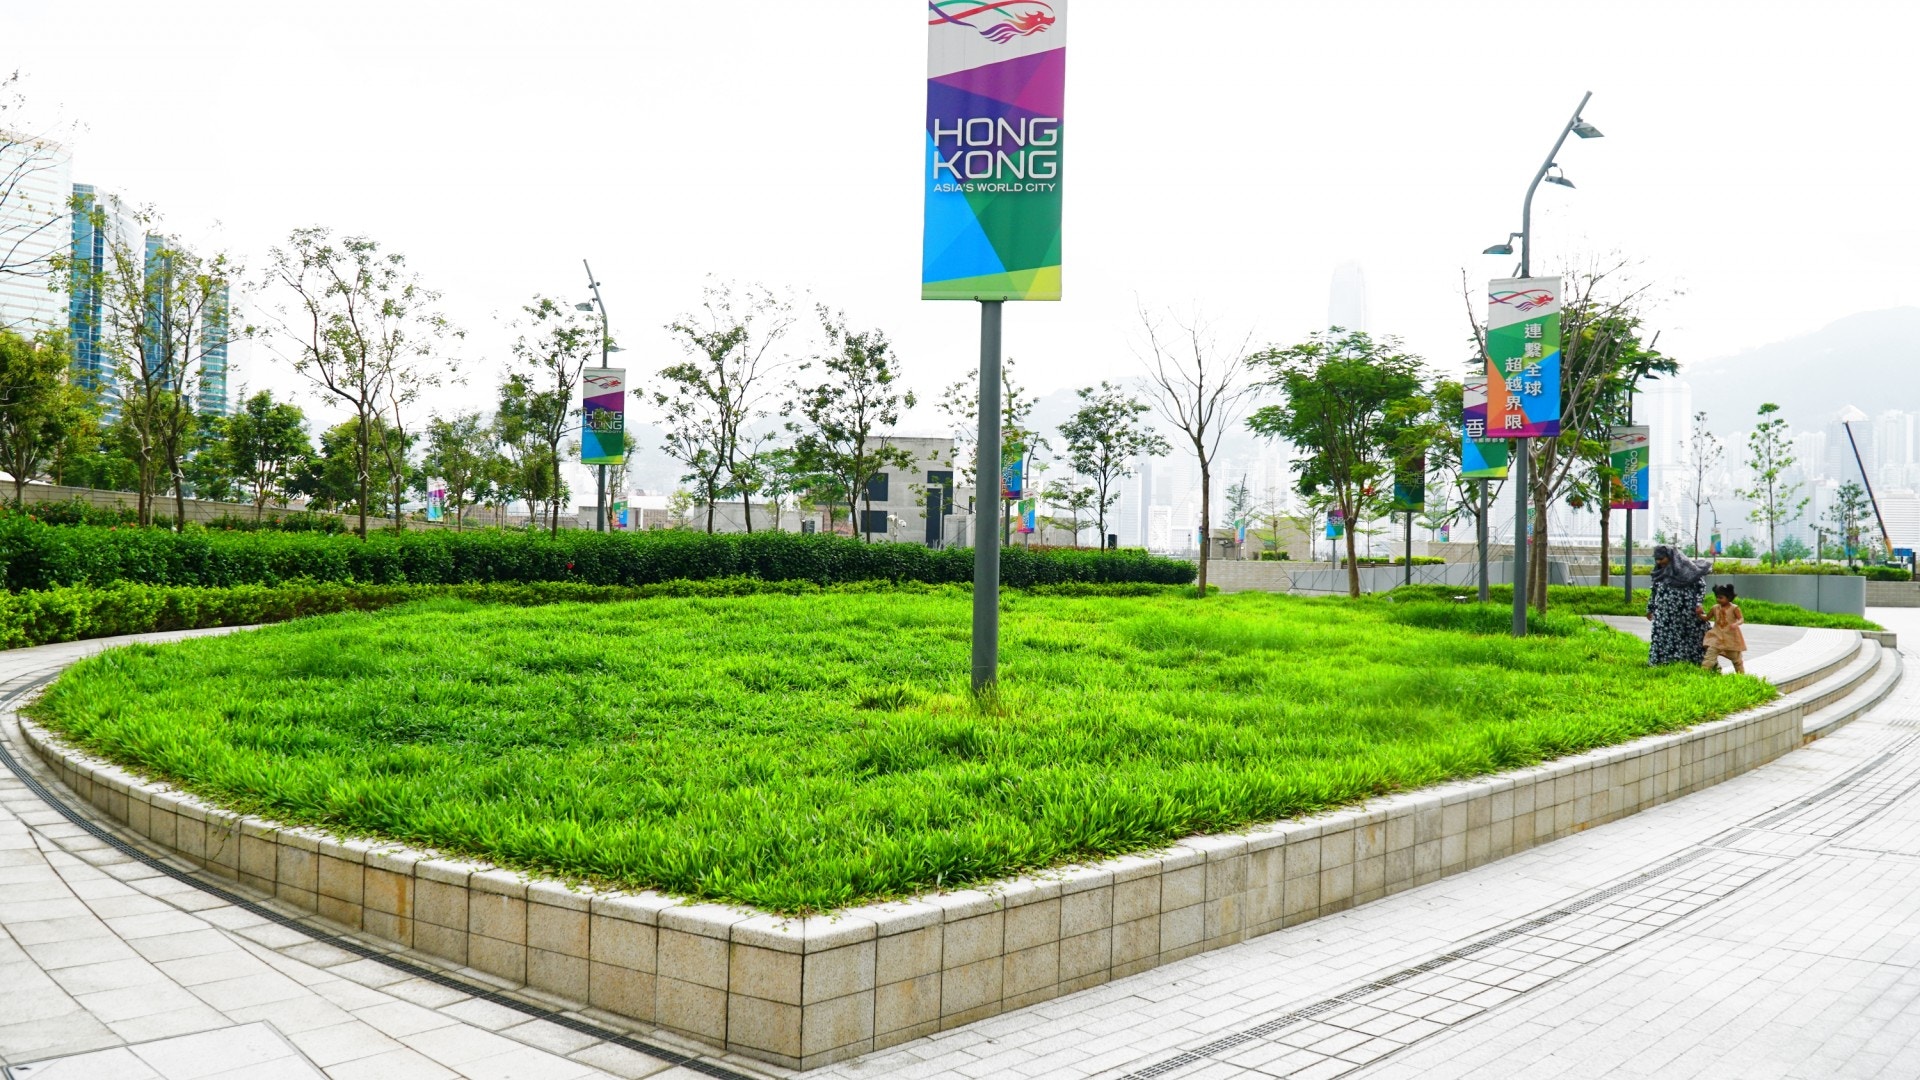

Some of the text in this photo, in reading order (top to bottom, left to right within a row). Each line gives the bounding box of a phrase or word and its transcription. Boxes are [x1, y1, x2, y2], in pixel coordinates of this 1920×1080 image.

[934, 117, 1058, 147] HONG
[933, 150, 1057, 180] KONG
[933, 183, 1056, 193] ASIA'S WORLD CITY
[1505, 357, 1523, 430] 超越界限
